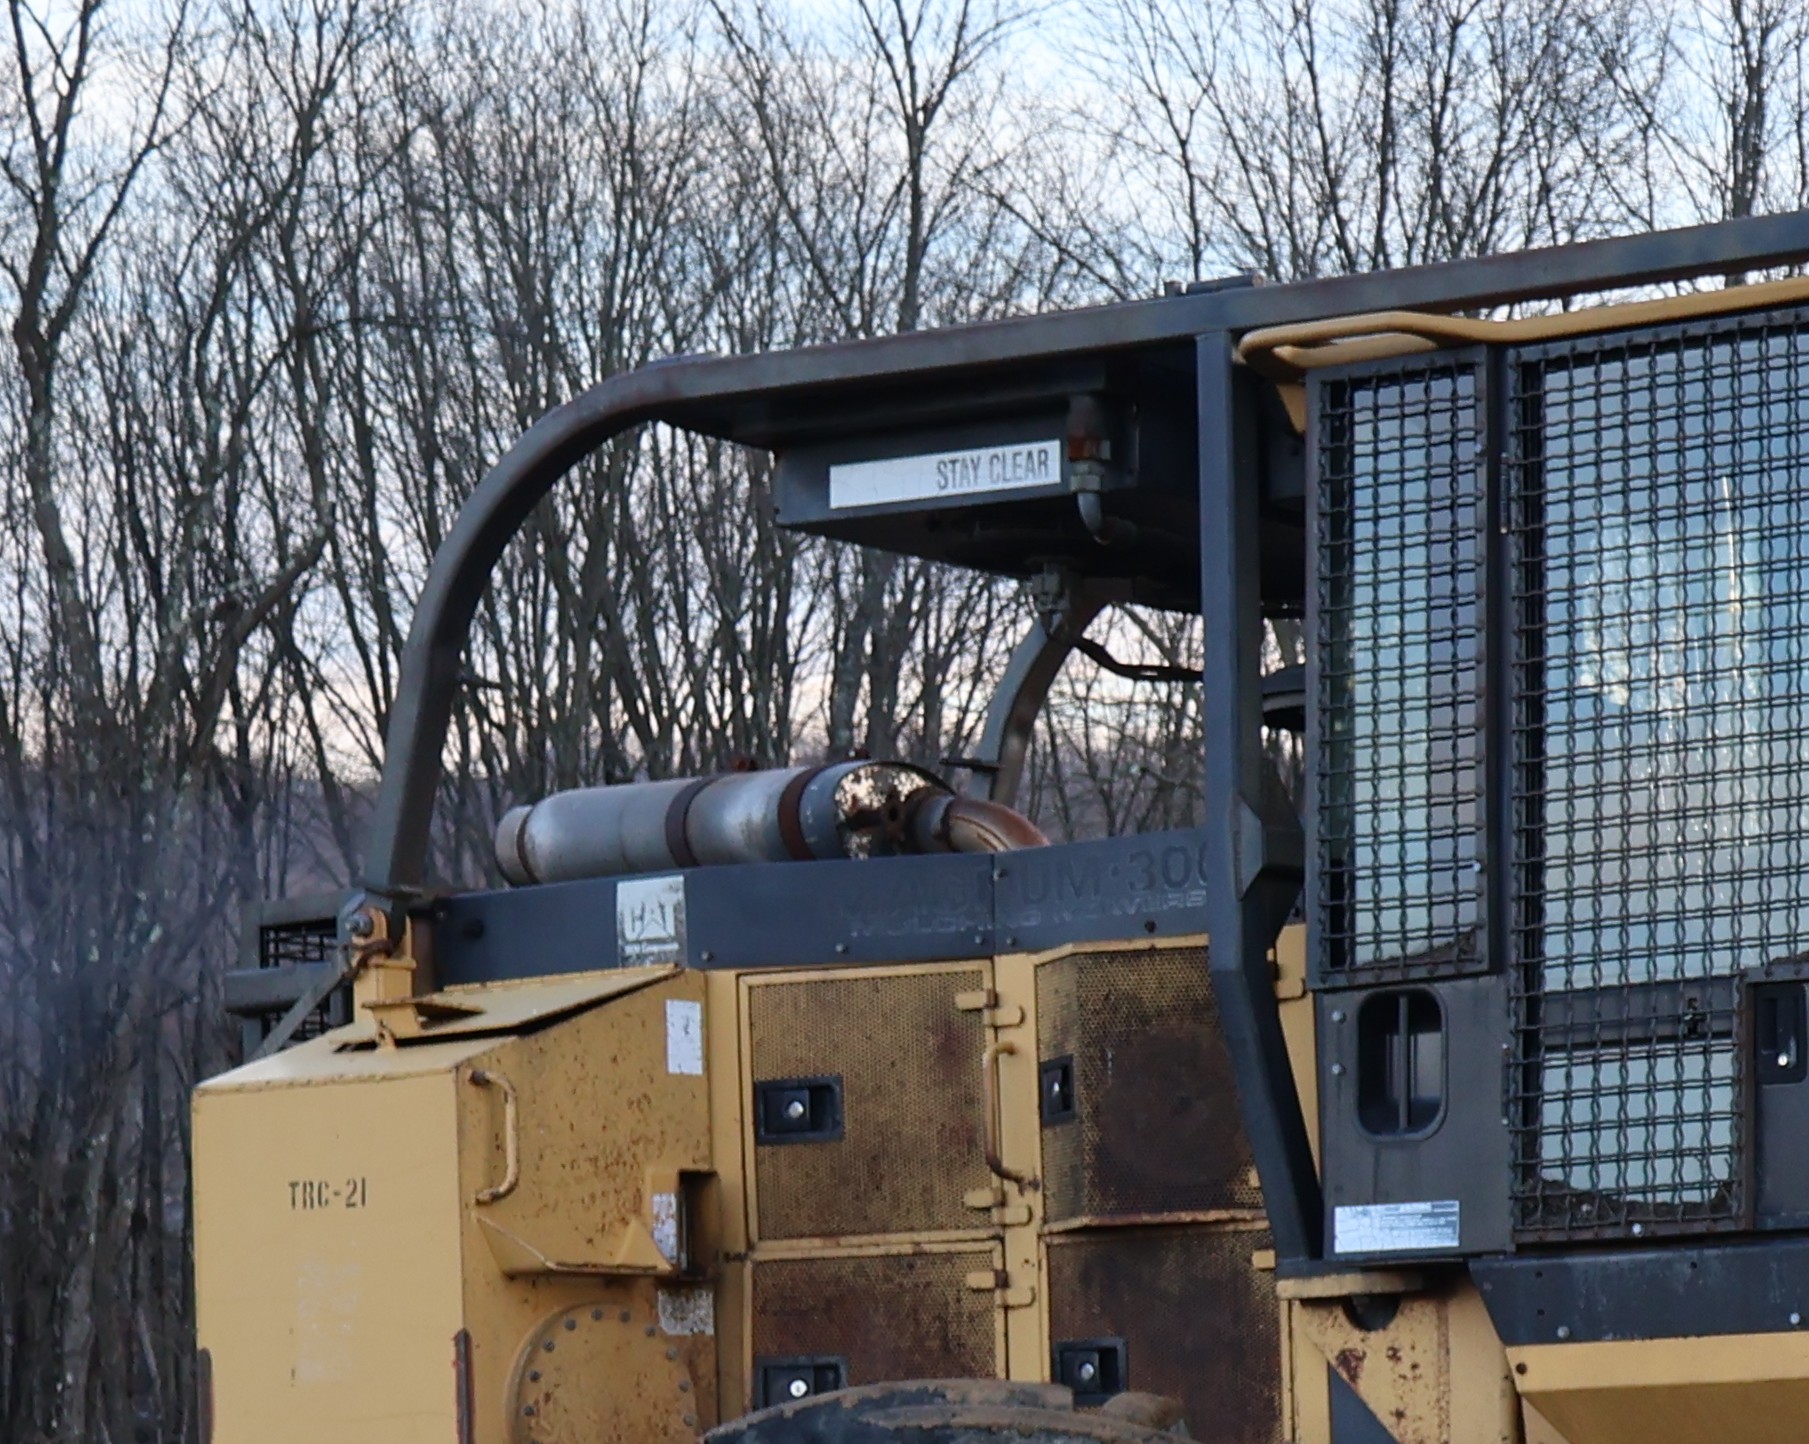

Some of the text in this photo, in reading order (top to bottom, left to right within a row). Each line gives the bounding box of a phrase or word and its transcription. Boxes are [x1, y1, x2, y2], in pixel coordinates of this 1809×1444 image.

[936, 449, 1049, 490] STAY CLEAR
[288, 1176, 367, 1210] TRC-21
